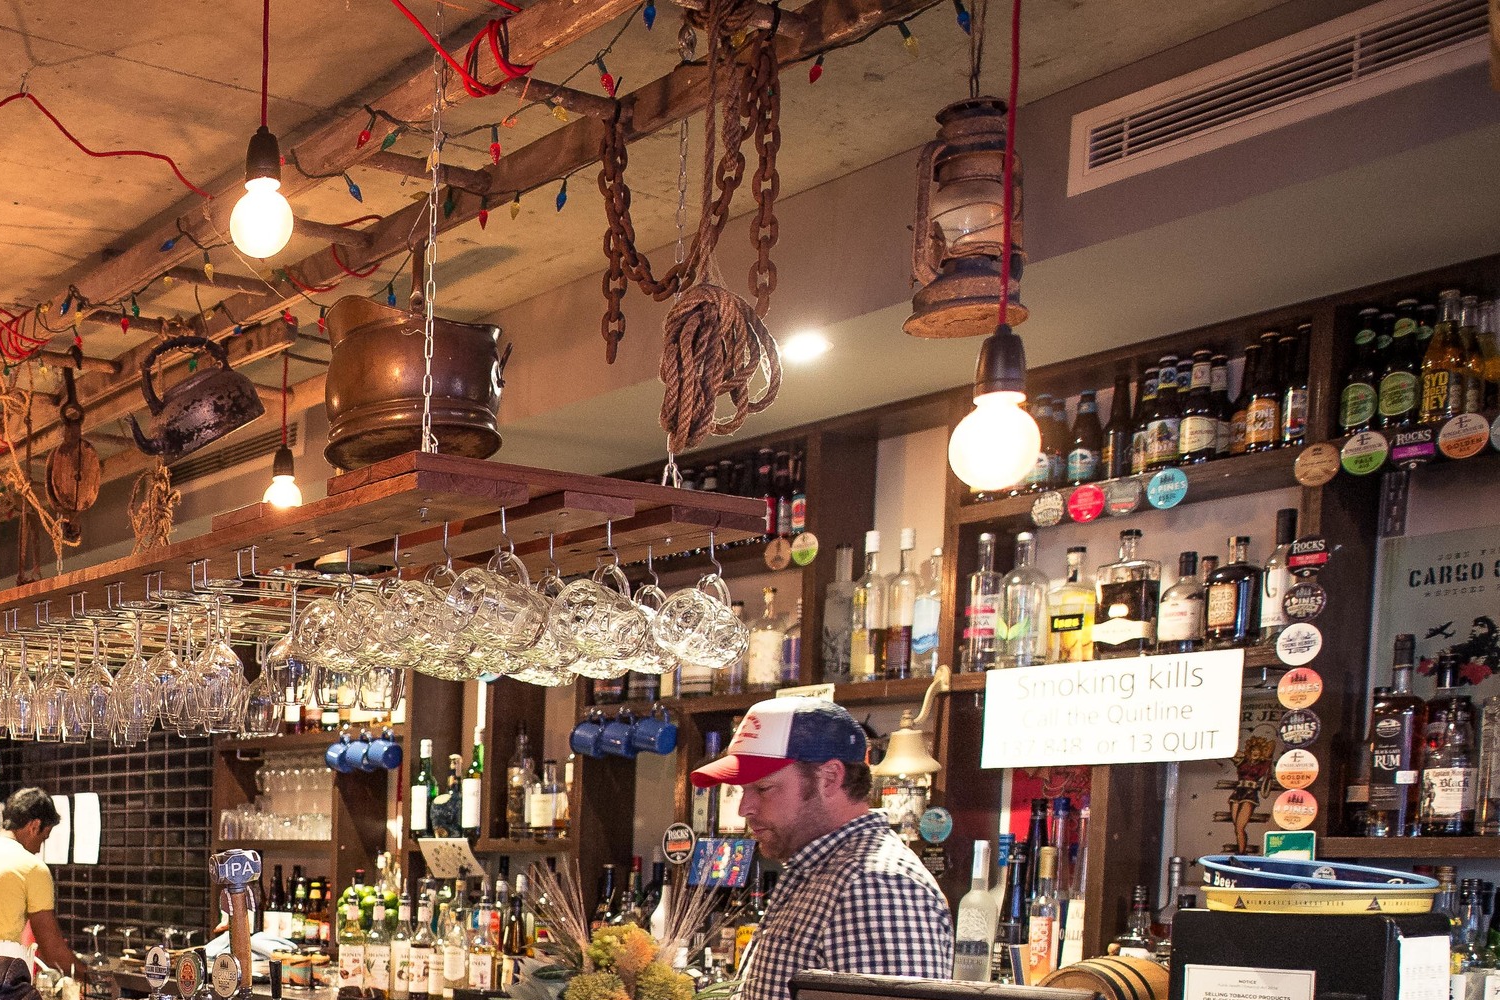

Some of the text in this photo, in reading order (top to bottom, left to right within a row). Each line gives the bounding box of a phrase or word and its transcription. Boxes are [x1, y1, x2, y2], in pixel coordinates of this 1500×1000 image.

[1423, 371, 1449, 388] SYD
[1422, 395, 1449, 412] NEY
[1396, 429, 1432, 446] ROCKS
[1157, 480, 1187, 494] PINES
[1292, 540, 1326, 554] ROCKS
[1408, 562, 1484, 588] CARGO
[1018, 660, 1204, 700] Smoking kills
[1286, 683, 1320, 694] PINES
[1022, 702, 1194, 730] Call the Quitline
[1287, 722, 1317, 732] PINES
[1097, 739, 1119, 754] or
[1130, 734, 1154, 754] 13
[1162, 729, 1220, 752] QUIT
[1374, 754, 1400, 770] RUM
[1282, 804, 1316, 816] PINES
[668, 829, 689, 840] ROCKS
[225, 861, 255, 878] IPA
